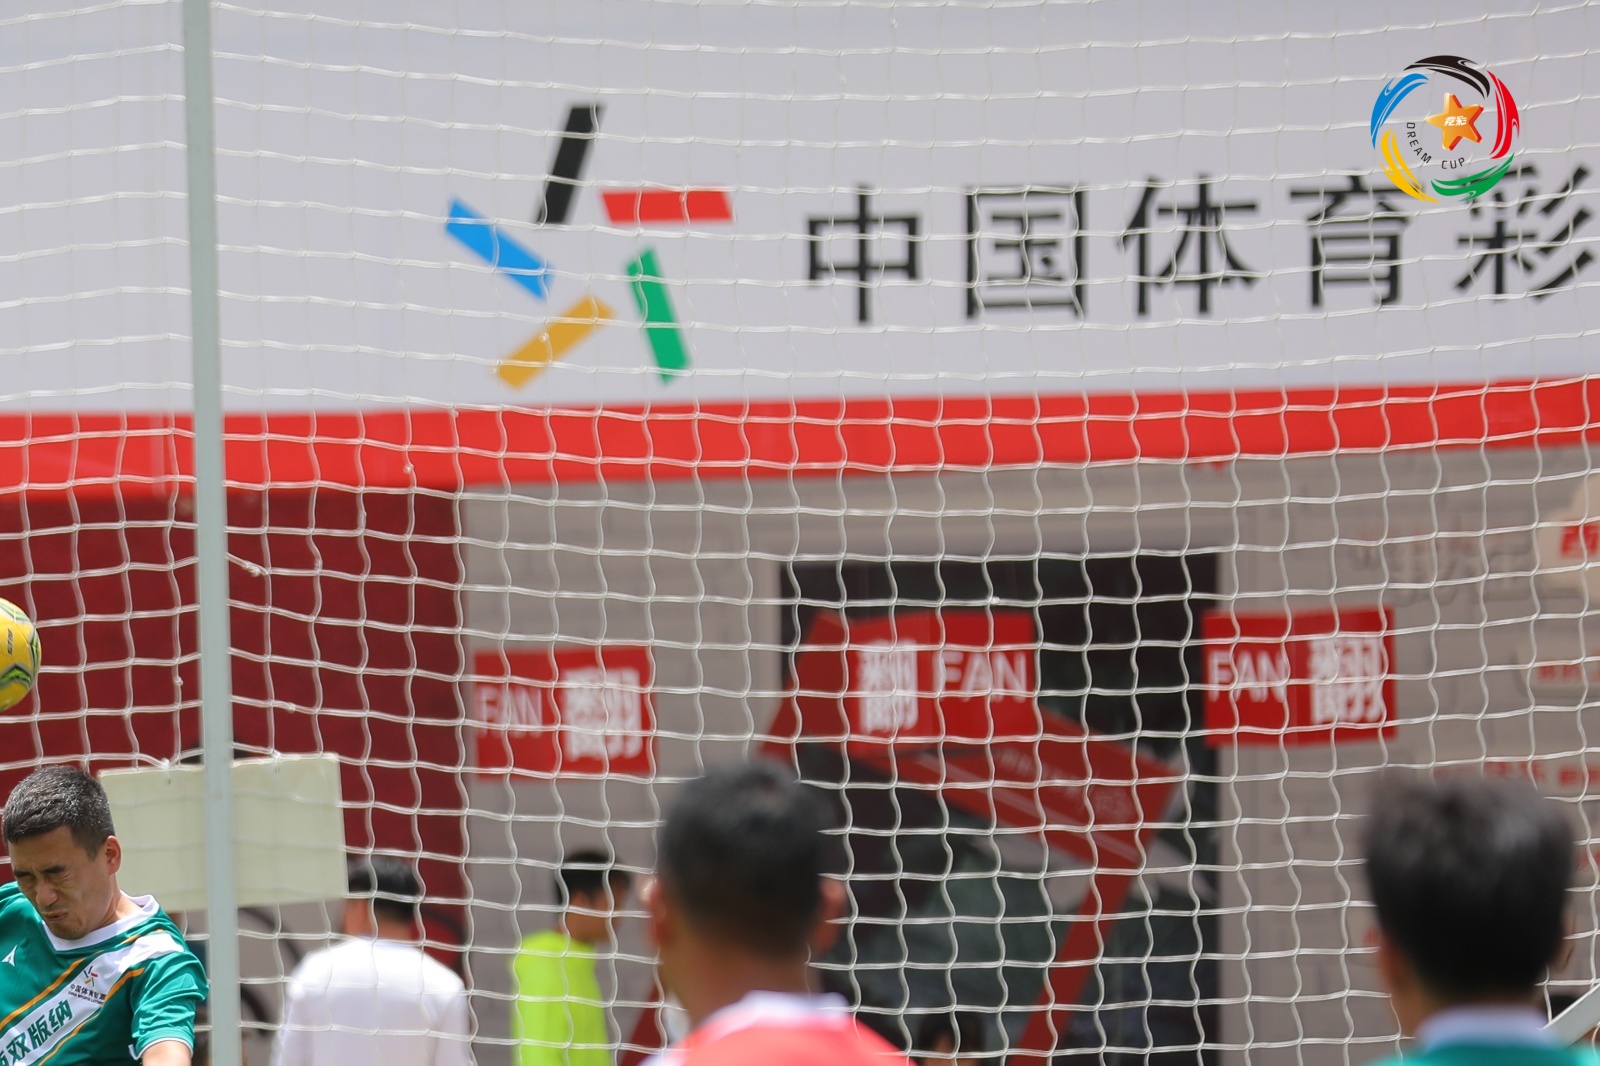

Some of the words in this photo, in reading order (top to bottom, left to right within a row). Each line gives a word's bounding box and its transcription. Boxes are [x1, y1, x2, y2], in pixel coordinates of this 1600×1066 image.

[804, 165, 1598, 326] 中国体育彩
[931, 649, 1029, 703] FAN
[1206, 649, 1289, 704] FAN
